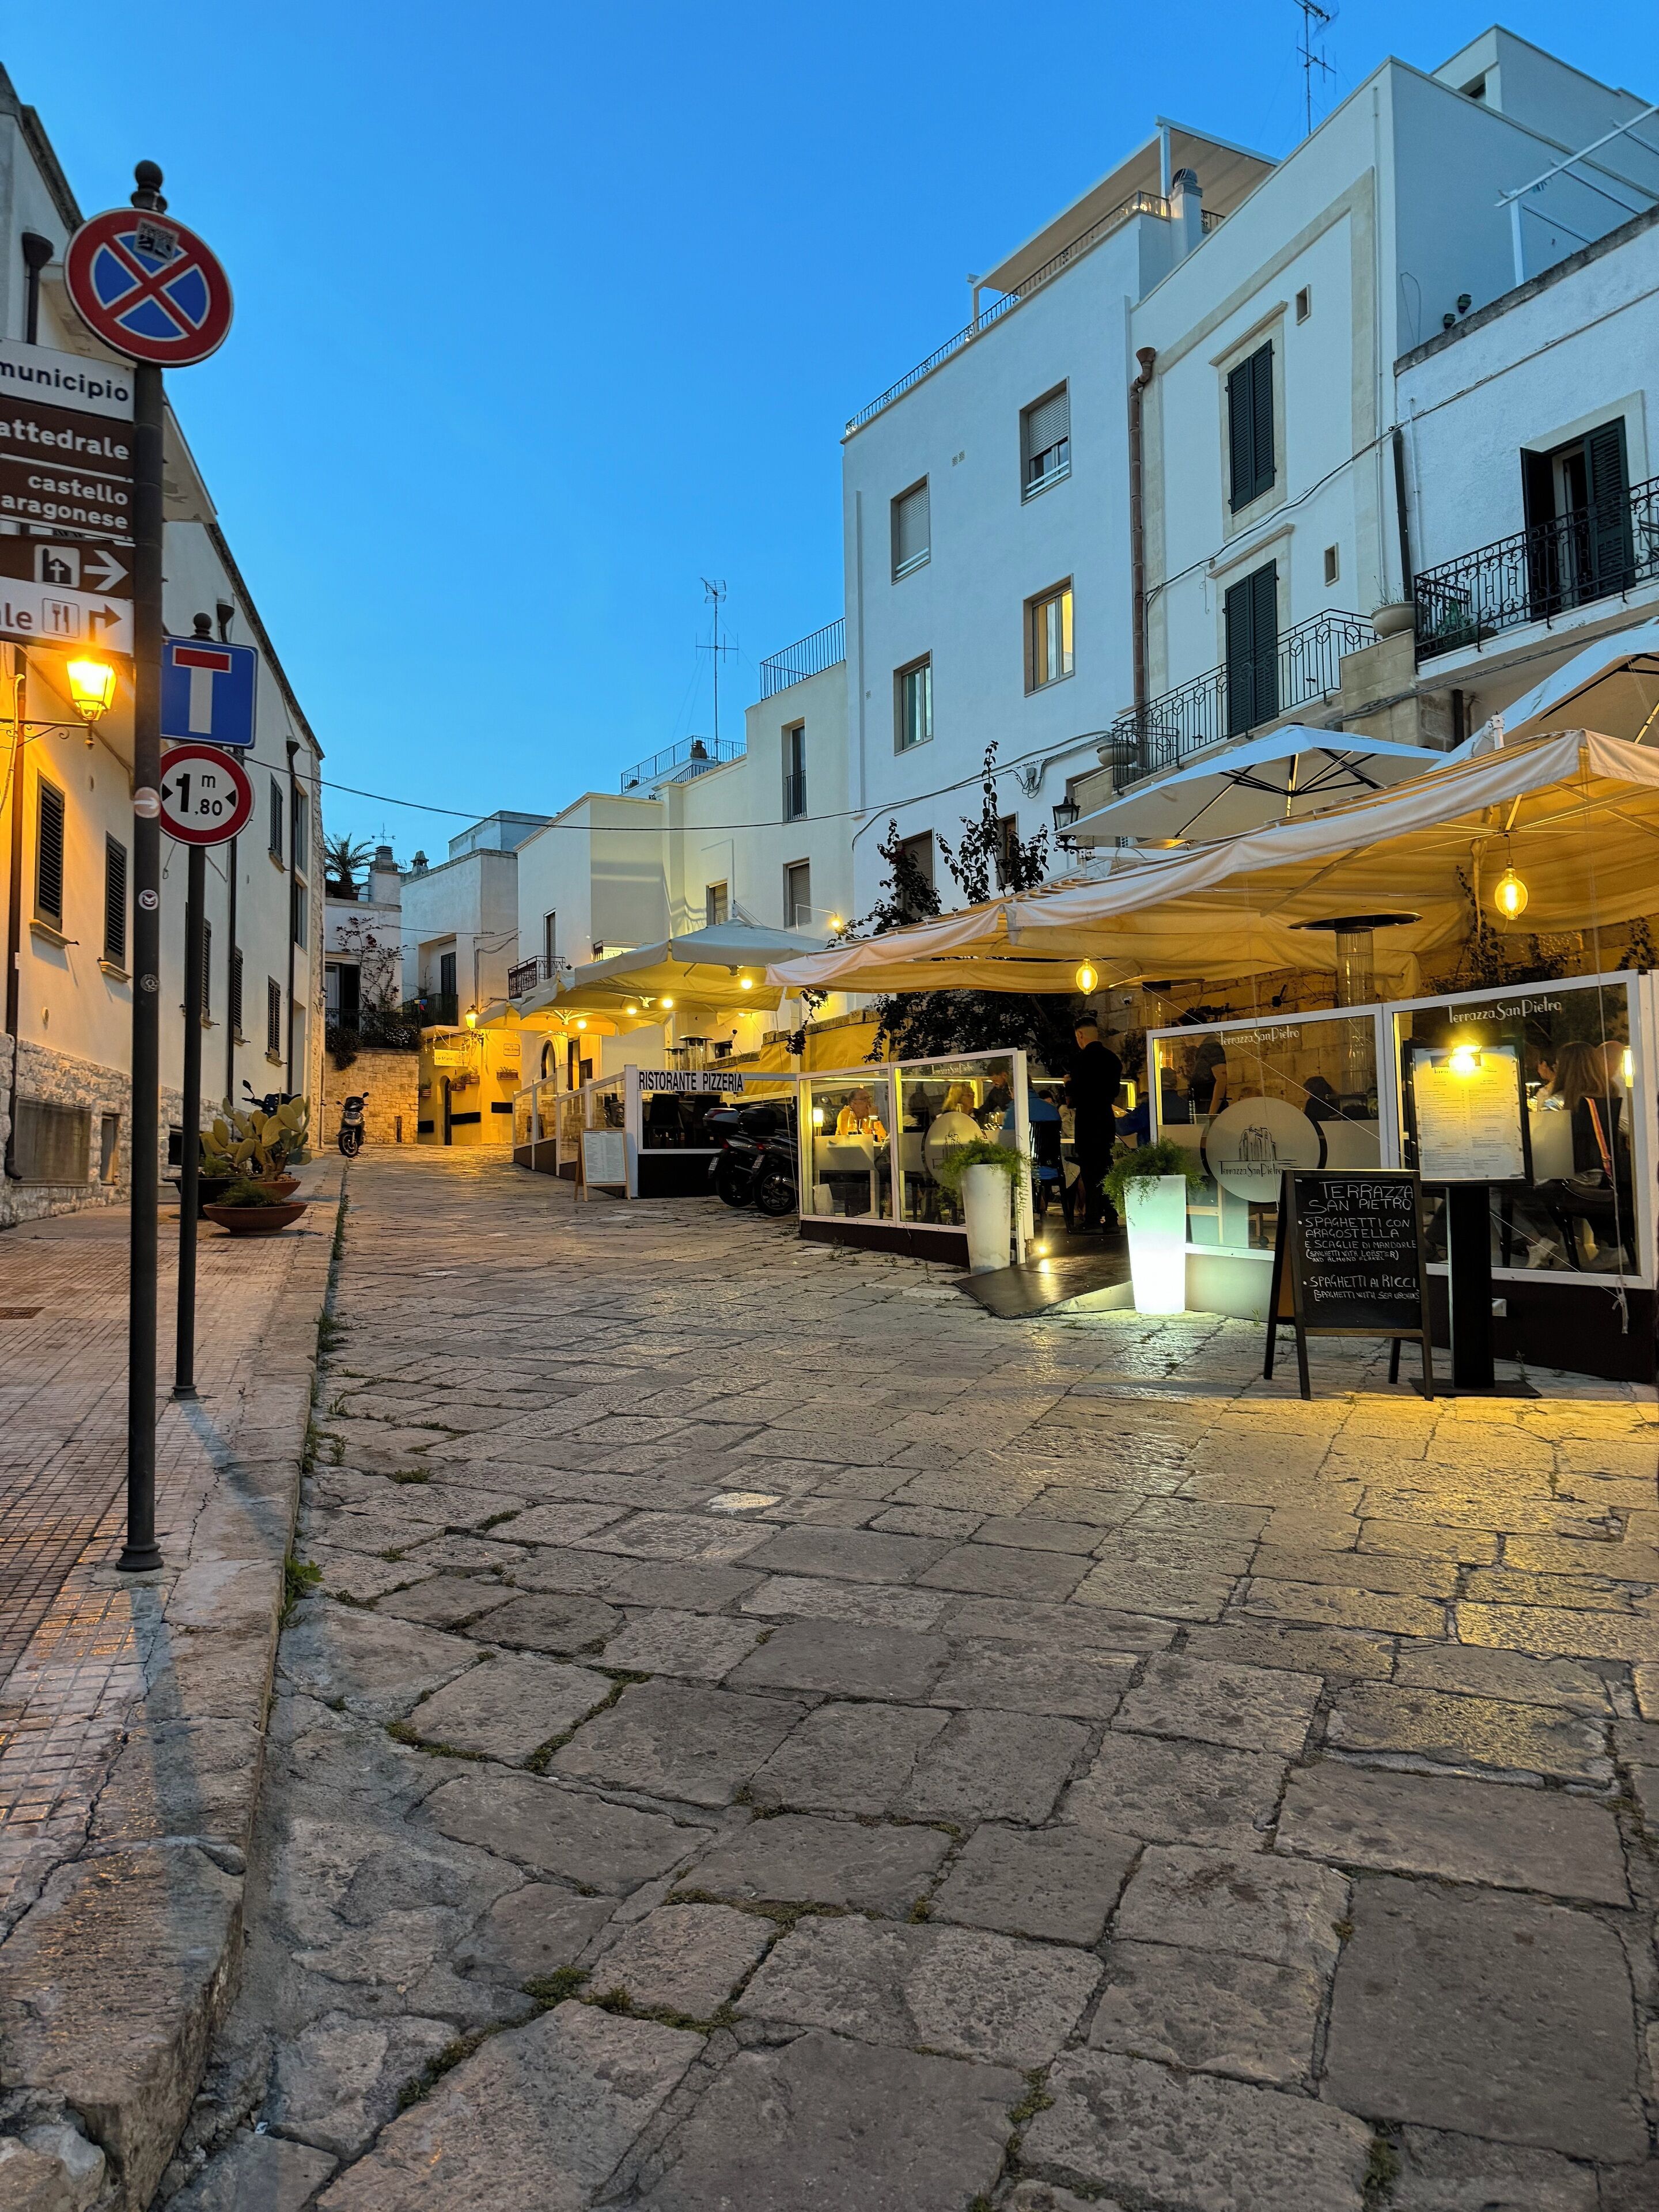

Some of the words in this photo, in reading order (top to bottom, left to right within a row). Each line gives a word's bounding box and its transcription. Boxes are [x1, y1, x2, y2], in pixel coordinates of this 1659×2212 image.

[0, 361, 129, 402] municipio
[28, 473, 128, 506] castello
[1, 493, 128, 529] aragonese
[0, 603, 33, 630] le
[639, 1071, 697, 1090] RISTORANTE
[703, 1073, 744, 1092] PIZZERIA
[1319, 1180, 1414, 1199] TERRAZZA
[1302, 1199, 1350, 1214] SAN
[1359, 1197, 1412, 1211] PIETRO
[1305, 1216, 1382, 1228] SPAGHETTI
[1385, 1219, 1411, 1228] CON
[1305, 1229, 1400, 1238] ARAGOSTELLA
[1314, 1240, 1359, 1249] SCAGLIE
[1373, 1240, 1417, 1249] MANDORLE
[1341, 1249, 1359, 1257] WITH
[1309, 1274, 1367, 1288] SPAGHETTI
[1382, 1274, 1416, 1288] RICCI
